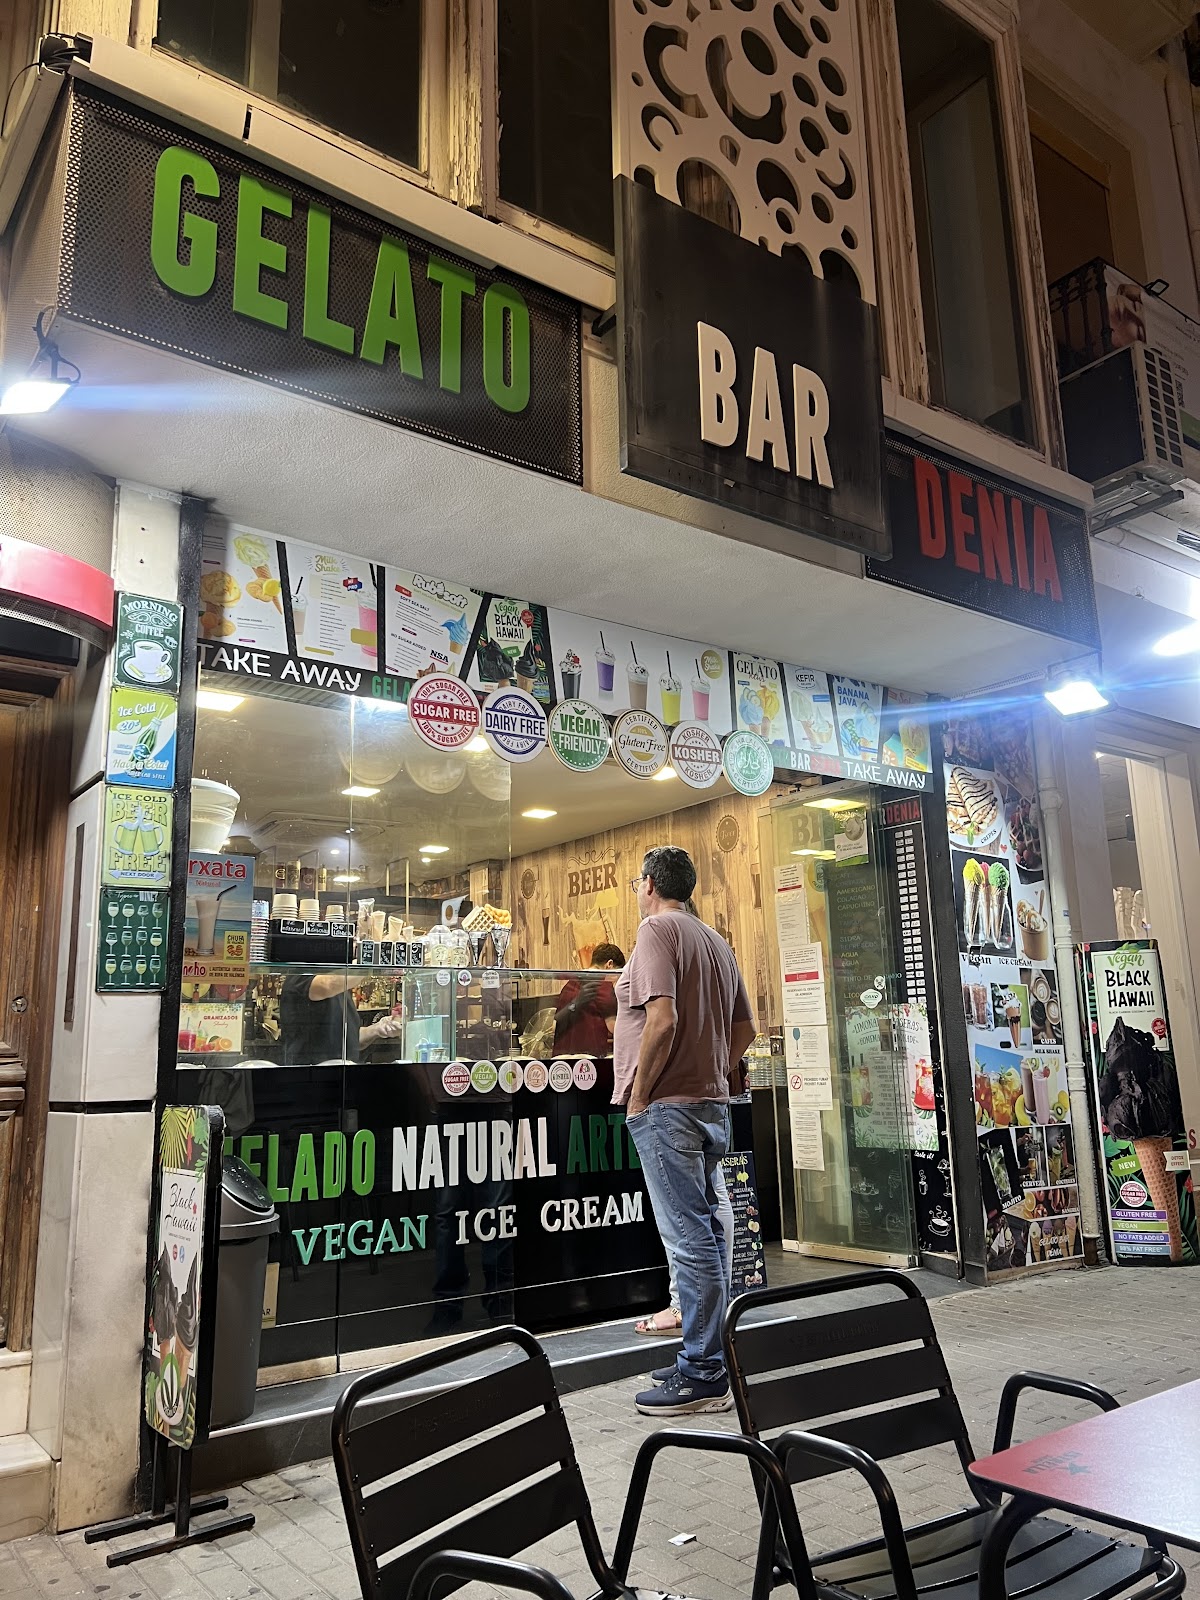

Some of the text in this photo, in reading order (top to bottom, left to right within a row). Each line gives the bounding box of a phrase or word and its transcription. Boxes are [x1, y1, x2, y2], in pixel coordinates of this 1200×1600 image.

[150, 145, 531, 414] GELATO
[696, 321, 835, 490] BAR
[913, 456, 1064, 603] DENIA
[122, 600, 178, 623] MORNING
[494, 602, 520, 617] Vegan
[494, 613, 523, 628] BLACK
[496, 626, 525, 640] HAWAII
[430, 649, 449, 663] NSA
[198, 642, 362, 692] TAKE AWAY
[736, 659, 778, 680] GELATO
[795, 673, 815, 683] KEFIR
[436, 682, 457, 692] SUGAR
[456, 688, 469, 704] FREE
[837, 686, 869, 700] BANANA
[118, 702, 156, 717] Ice Cold
[838, 698, 857, 708] JAVA
[413, 702, 477, 723] SUGAR FREE
[486, 713, 546, 736] DAIRY FREE
[560, 714, 600, 737] VEGAN
[626, 715, 658, 731] CERTIFIED
[437, 735, 457, 744] SUGAR
[458, 726, 470, 740] FREE
[619, 734, 665, 752] Gluten Free
[682, 729, 710, 743] KOSHER
[559, 734, 601, 755] FRIENDLY
[675, 746, 720, 763] KOSHER
[626, 757, 659, 772] CERTIFIED
[684, 766, 713, 780] KOSHER
[790, 751, 811, 771] BAR
[843, 760, 882, 782] TAKE
[886, 769, 925, 789] AWAY
[733, 772, 766, 789] CERTIFIED
[113, 793, 167, 803] ICE COLD
[111, 800, 167, 827] BEER
[886, 800, 920, 824] DENIA
[109, 846, 167, 873] FREE
[188, 859, 246, 879] rxata
[568, 862, 618, 898] BEER
[837, 885, 876, 895] AMERICANO
[998, 957, 1010, 965] ICE
[1107, 952, 1145, 971] Vegan
[1105, 970, 1151, 987] BLACK
[1107, 990, 1155, 1008] HAWAII
[1188, 1128, 1197, 1150] S
[223, 1129, 376, 1203] ELADO
[392, 1116, 557, 1192] NATURAL
[721, 1155, 749, 1167] ASERAS
[1118, 1160, 1136, 1170] NEW
[1002, 1195, 1022, 1210] MOJITO
[292, 1191, 645, 1266] VEGAN ICE CREAM
